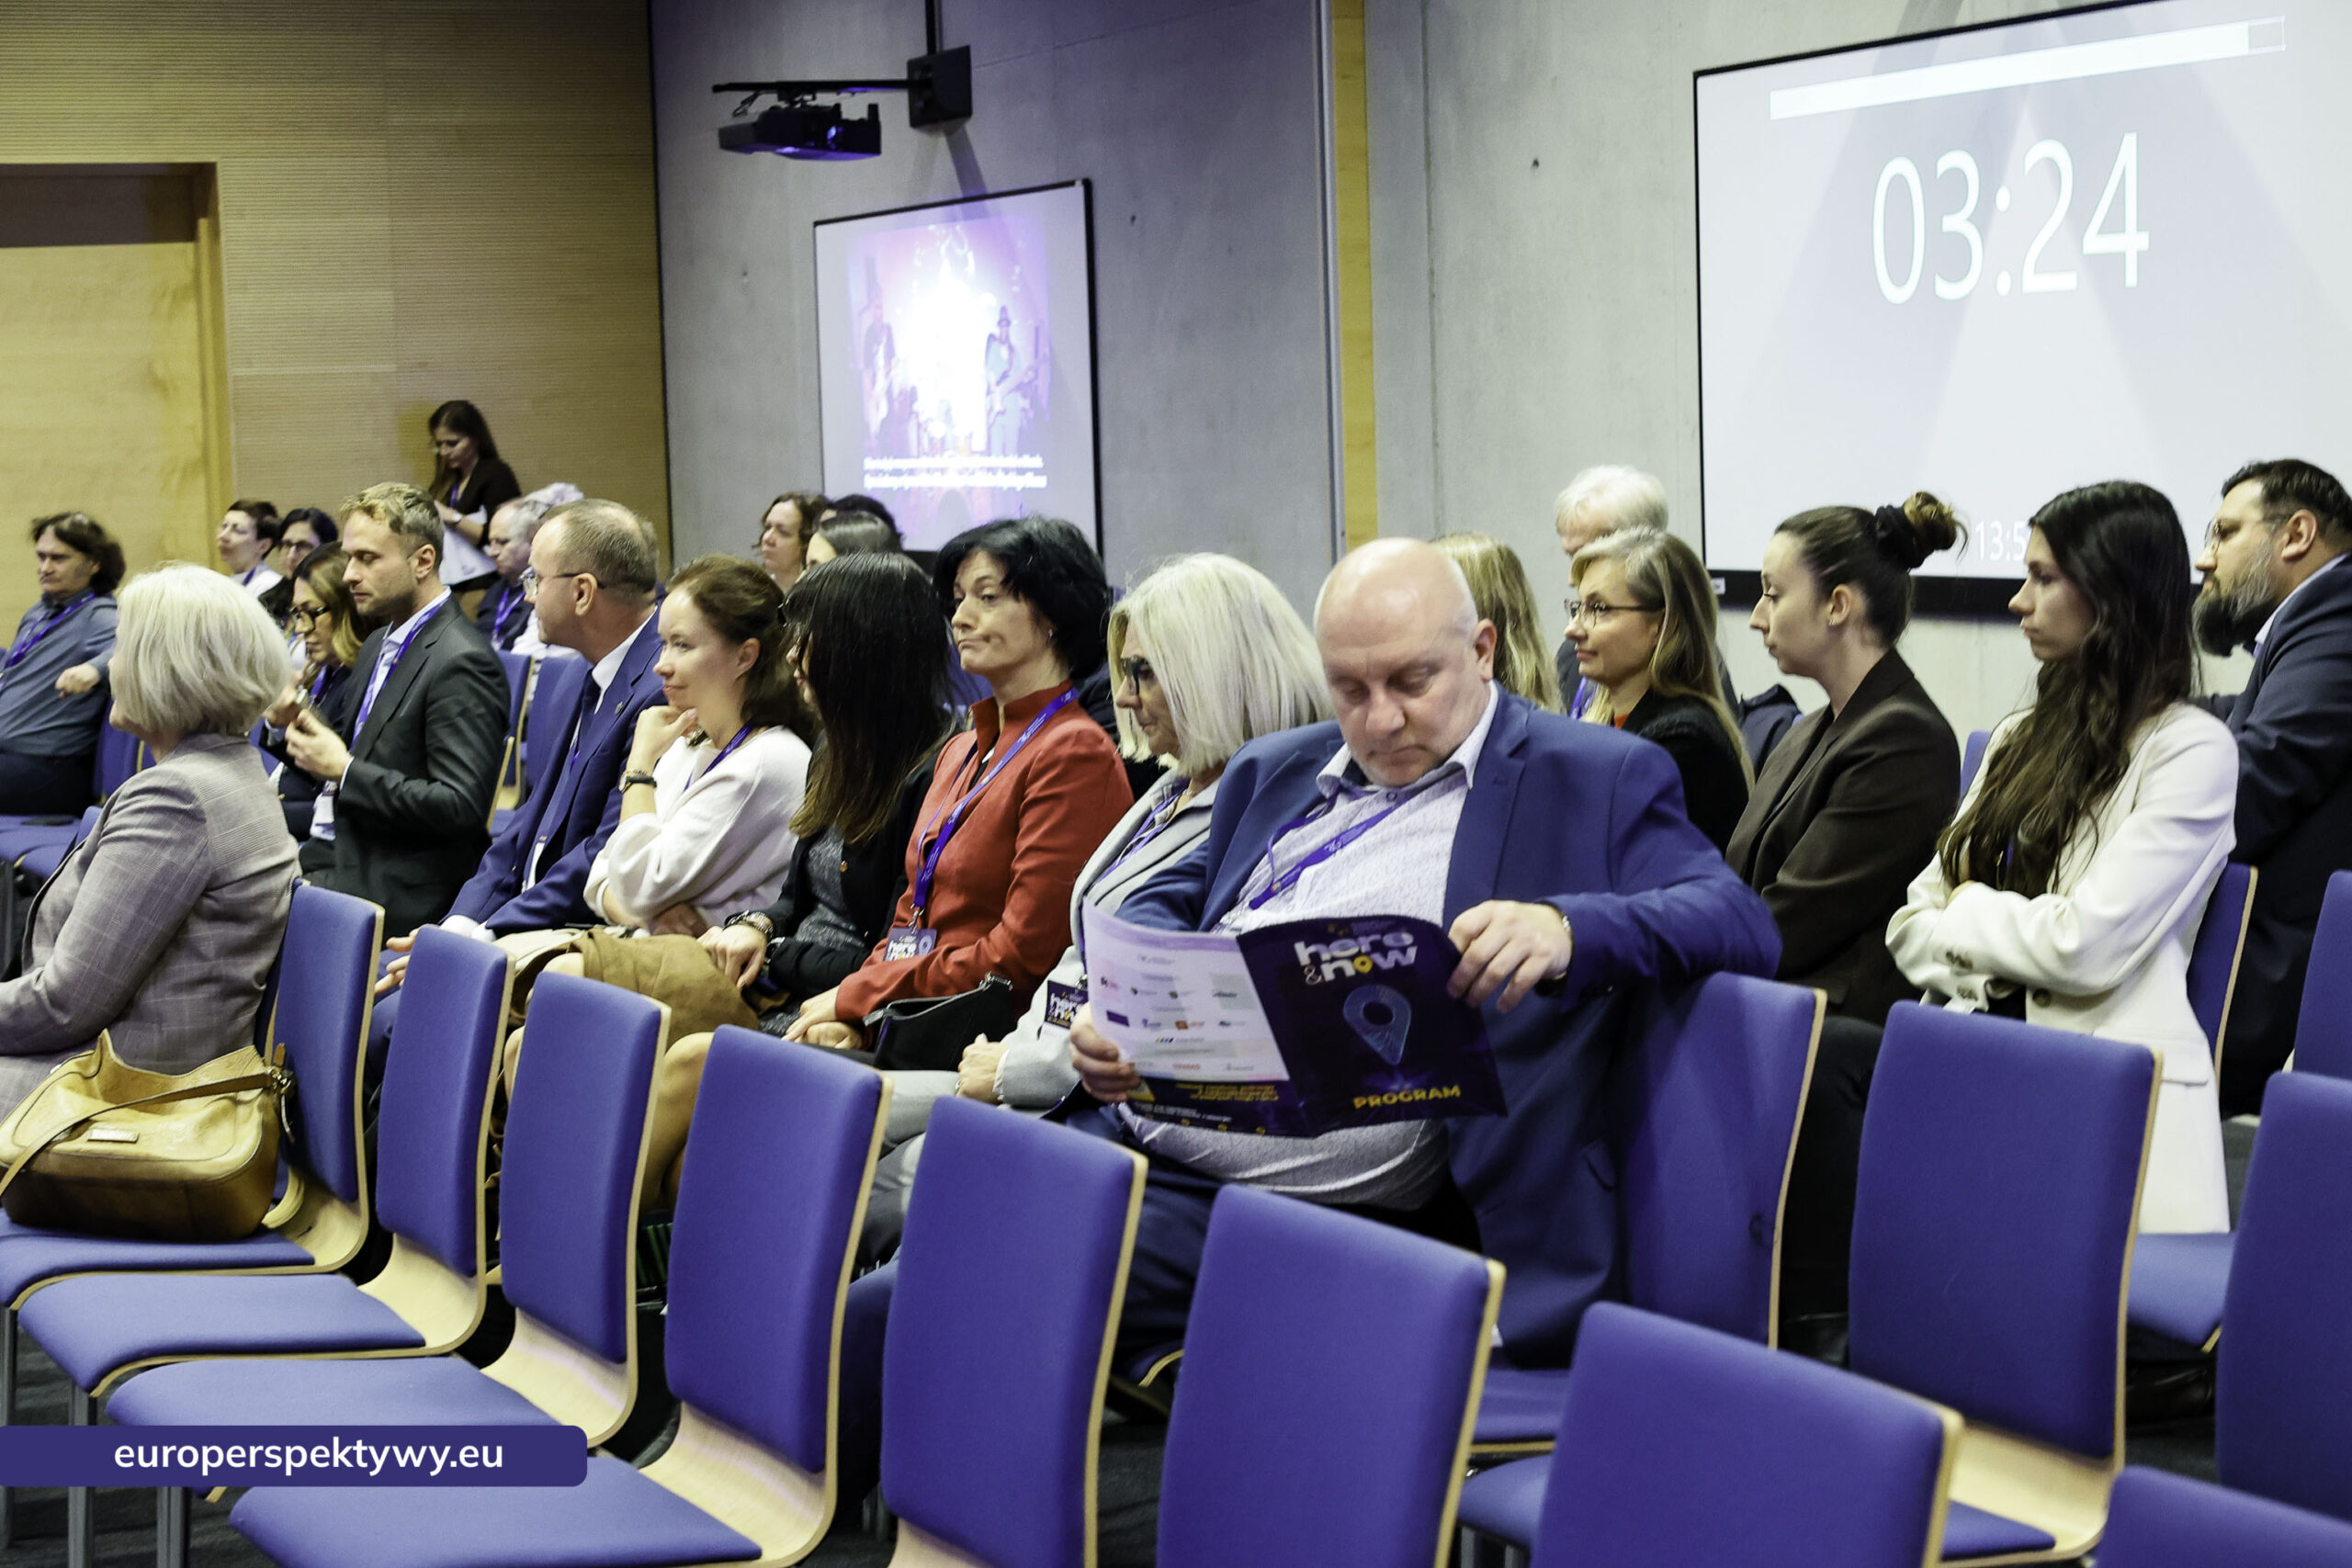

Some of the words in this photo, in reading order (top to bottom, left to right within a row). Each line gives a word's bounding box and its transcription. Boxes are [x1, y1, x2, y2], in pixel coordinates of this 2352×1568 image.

[1871, 131, 2150, 304] 03:24
[1975, 519, 2031, 561] 13:5
[1320, 946, 1418, 983] now
[1352, 1084, 1461, 1109] PROGRAM
